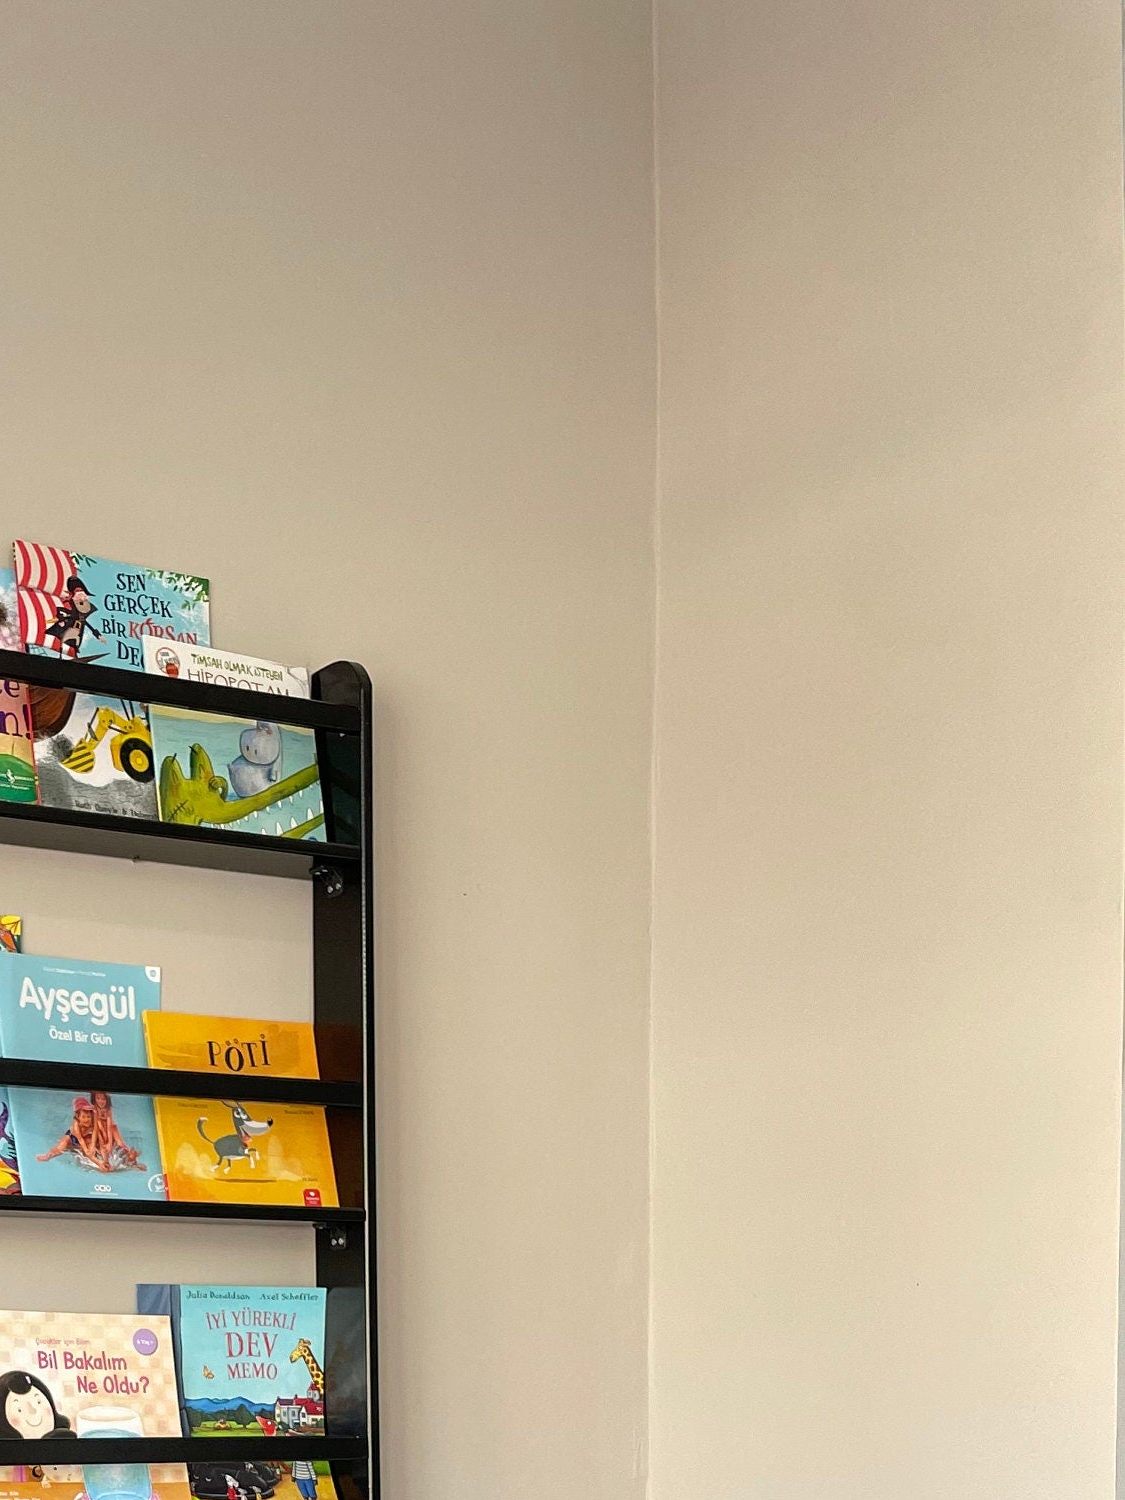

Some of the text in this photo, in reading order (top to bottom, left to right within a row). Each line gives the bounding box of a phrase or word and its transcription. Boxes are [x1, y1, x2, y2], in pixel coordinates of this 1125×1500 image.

[116, 573, 146, 593] SEN
[104, 594, 173, 618] GERÇEK
[101, 615, 127, 638] BİR
[117, 640, 144, 668] DE
[224, 661, 253, 677] OLMAK
[19, 976, 136, 1026] Ayşegül
[49, 1025, 113, 1046] Özel Bir Gün
[206, 1033, 271, 1072] PÖTİ
[186, 1290, 208, 1299] Julia
[210, 1291, 250, 1300] Donaldson
[205, 1307, 297, 1331] İYİ YÜREKLİ
[225, 1332, 278, 1358] DEV
[37, 1350, 127, 1370] Bil Bakalım
[227, 1362, 278, 1380] MEMO
[76, 1374, 150, 1395] Ne Oldu?
